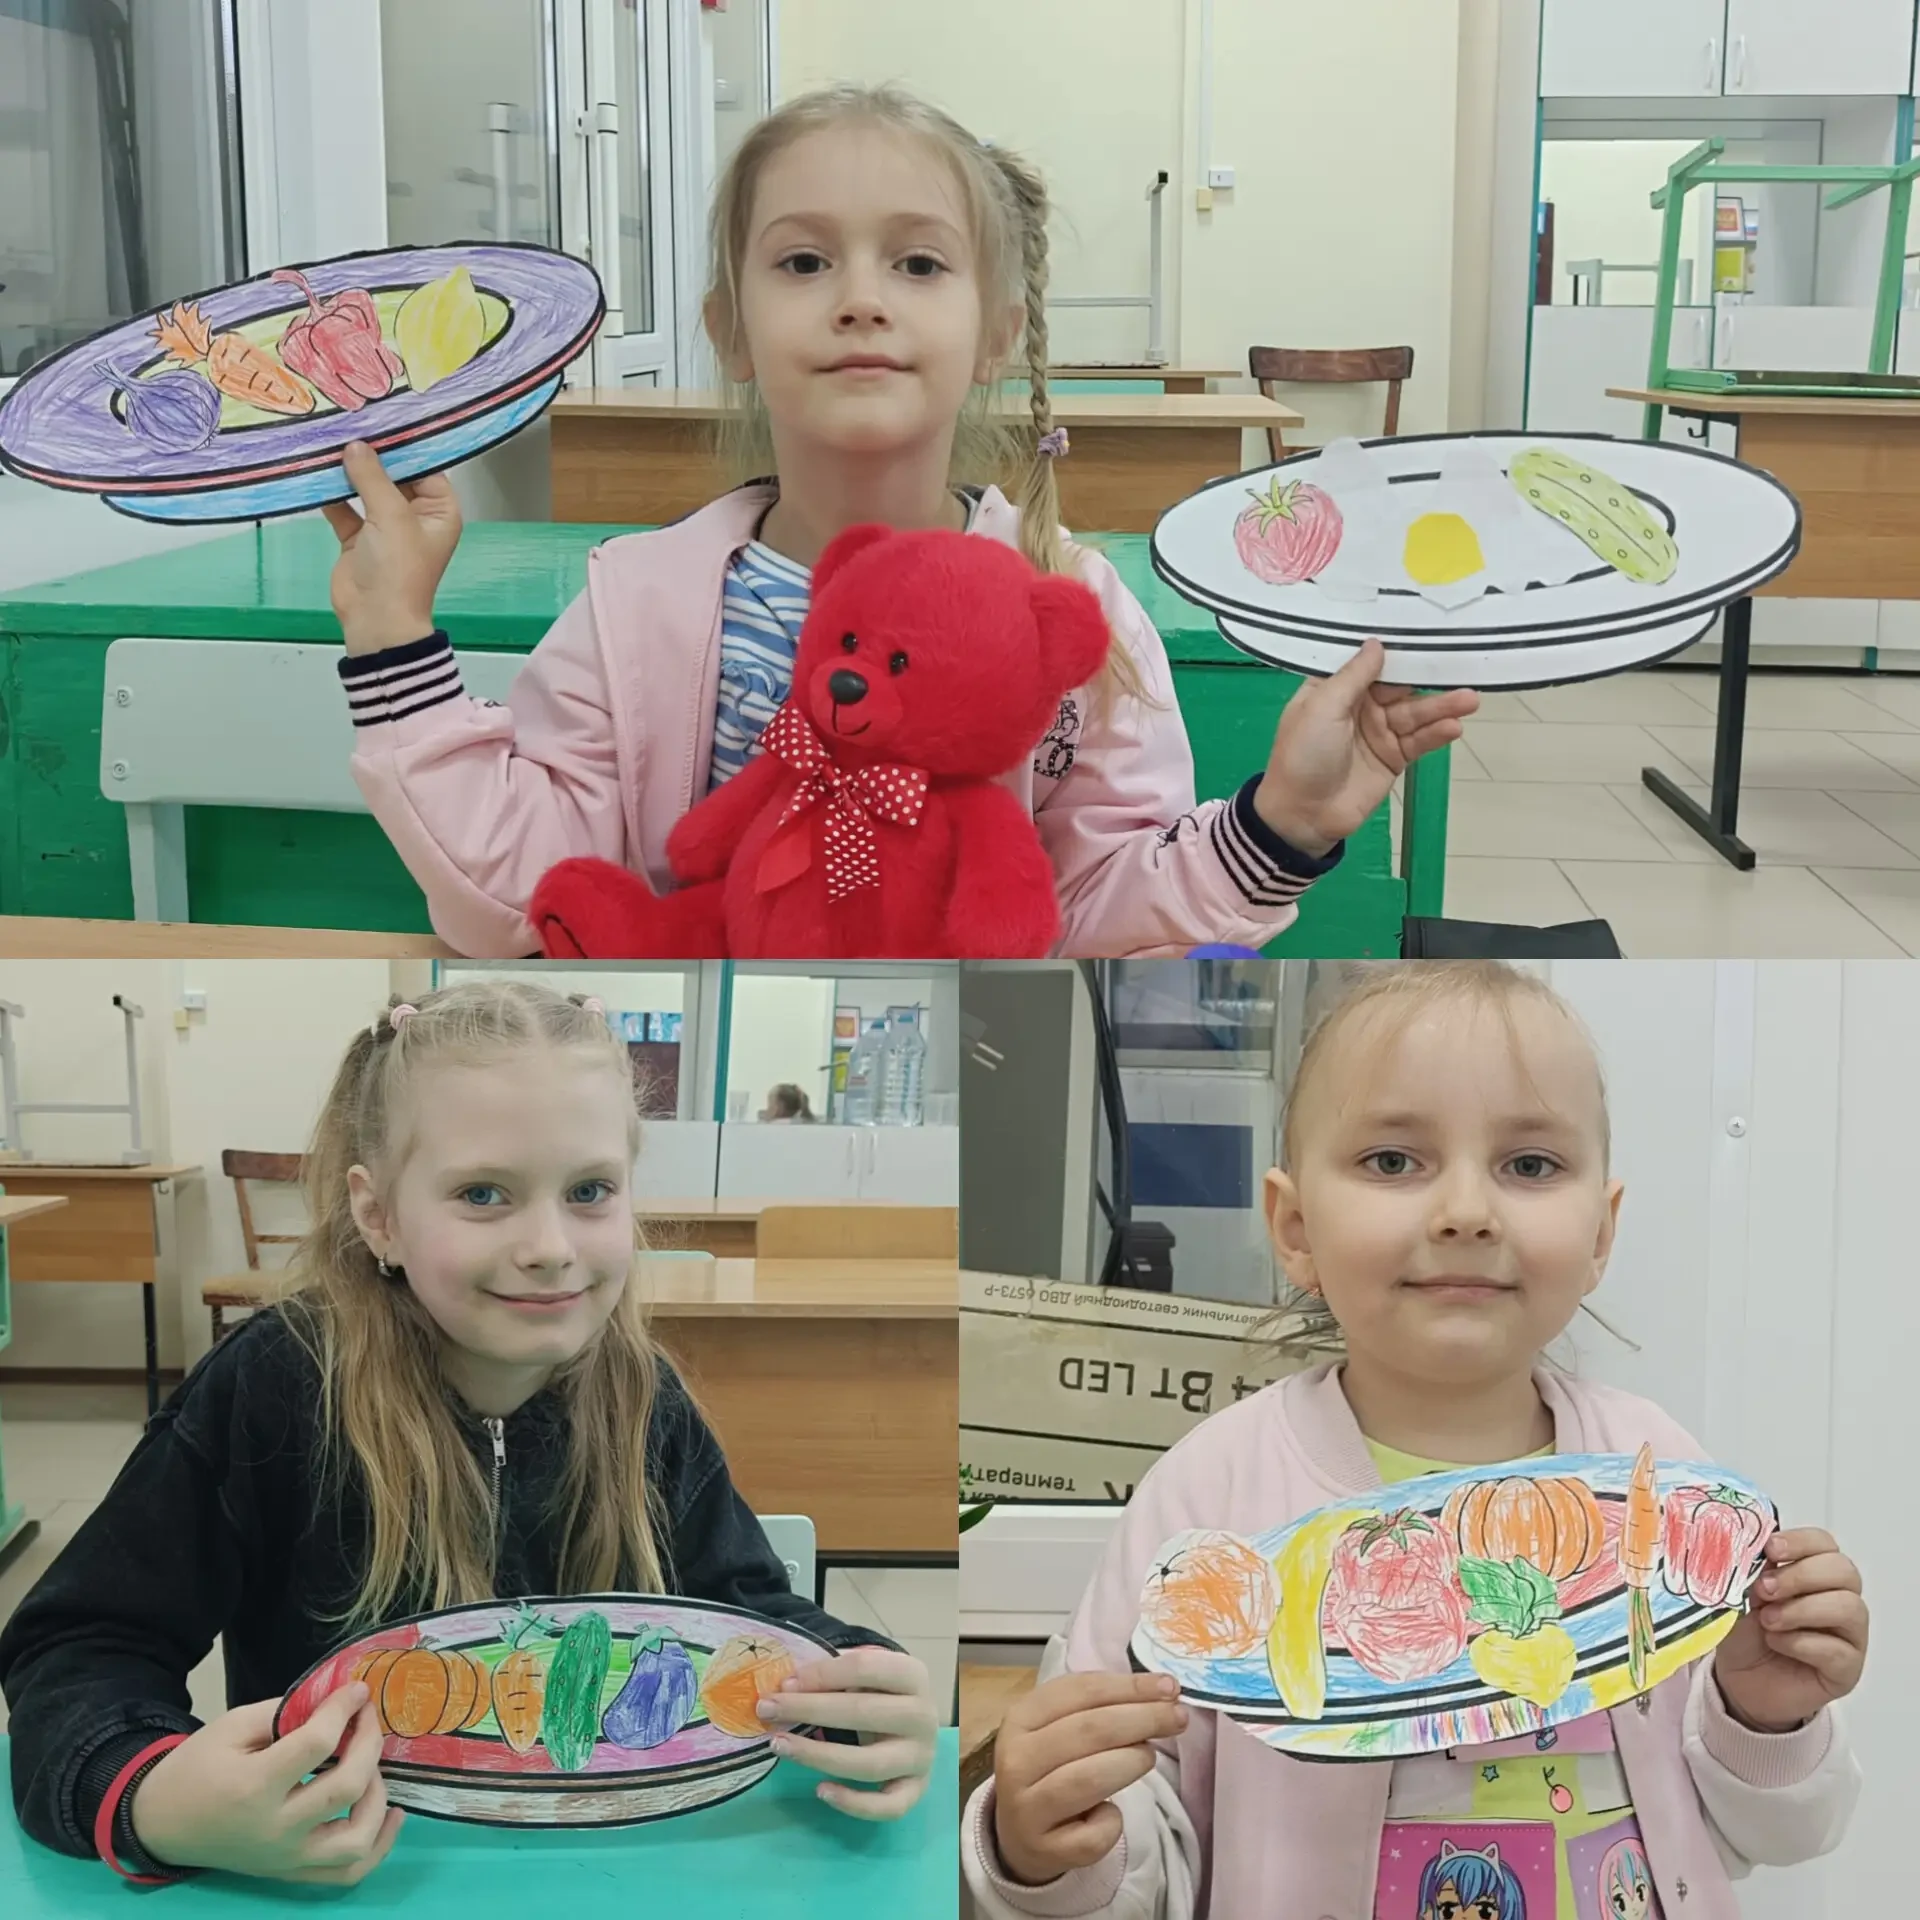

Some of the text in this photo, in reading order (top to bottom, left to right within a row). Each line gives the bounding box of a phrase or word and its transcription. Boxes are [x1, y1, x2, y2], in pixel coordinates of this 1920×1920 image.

[1039, 1289, 1072, 1305] ДВО
[1074, 1292, 1180, 1315] светодиодный
[1182, 1306, 1265, 1325] ветильник
[1059, 1357, 1135, 1396] LED
[1150, 1367, 1213, 1414] Вт
